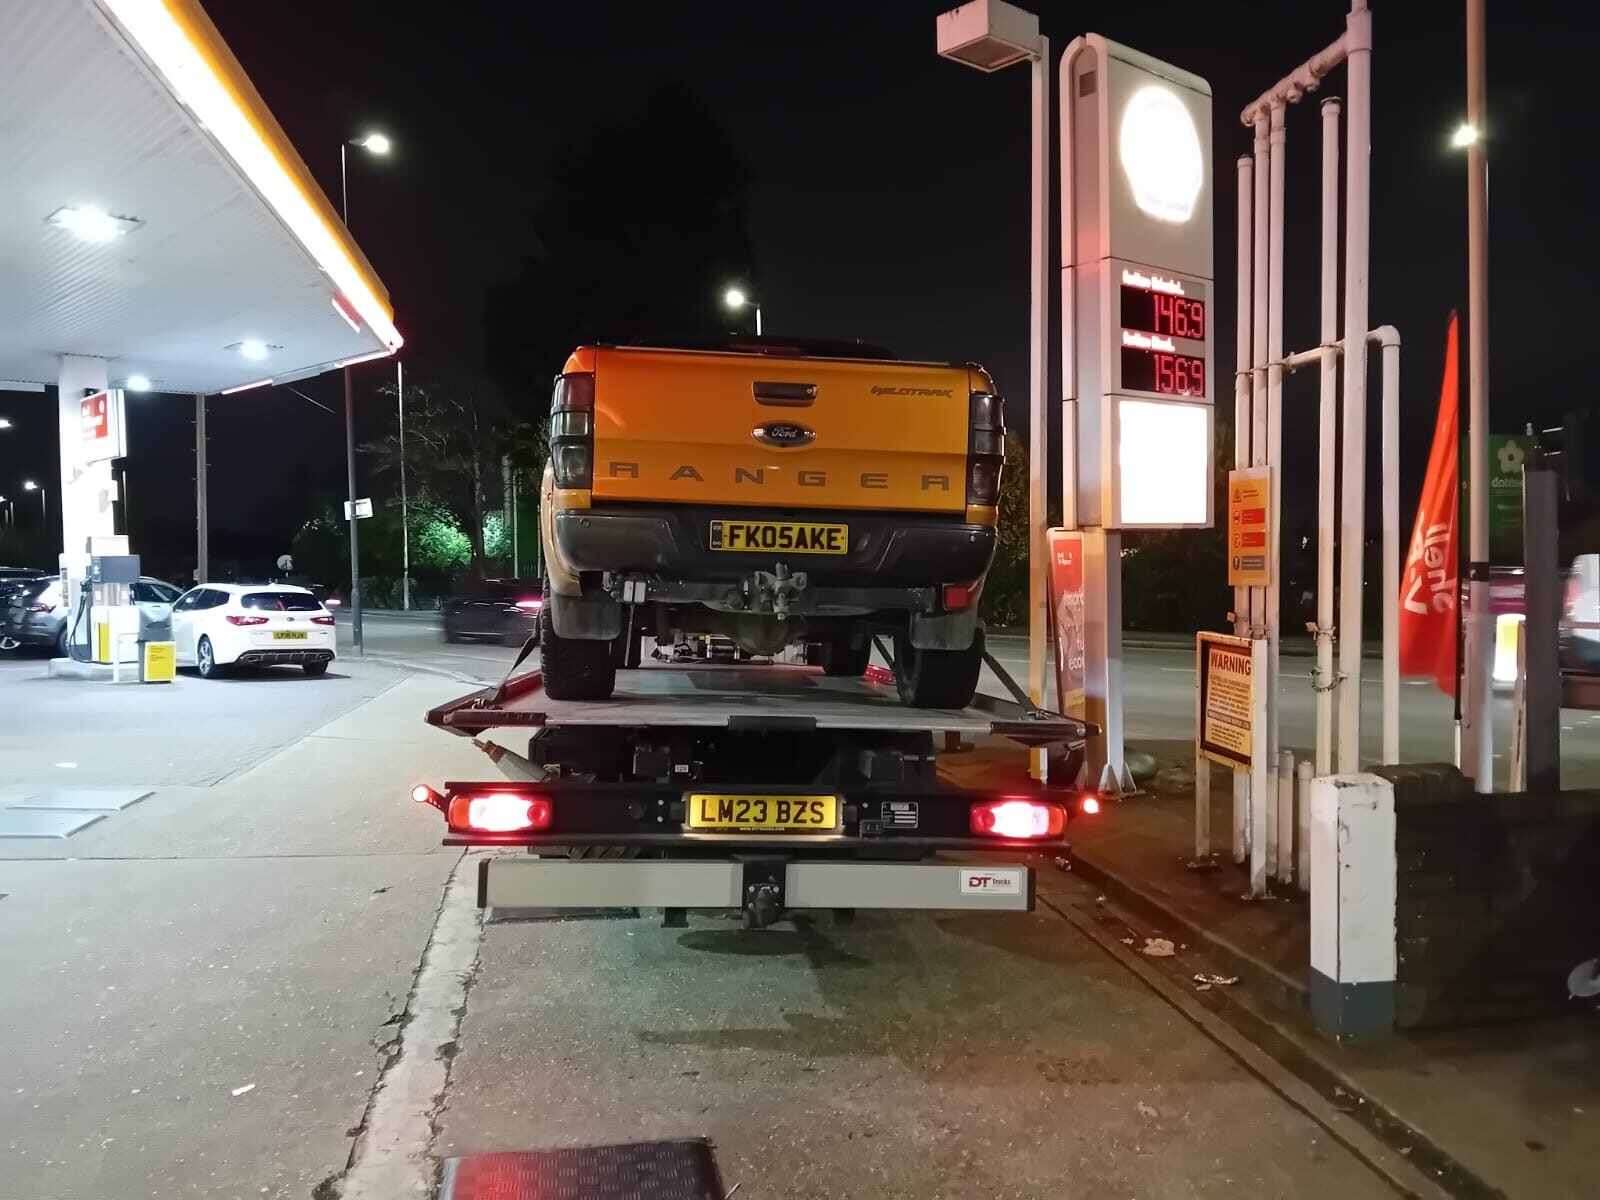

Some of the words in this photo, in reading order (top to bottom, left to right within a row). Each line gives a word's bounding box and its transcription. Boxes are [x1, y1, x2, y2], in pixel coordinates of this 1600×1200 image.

[1154, 294, 1203, 338] 146.9
[1154, 353, 1203, 396] 156.9
[870, 385, 953, 399] WILDTRAK
[771, 427, 798, 439] Ford
[609, 461, 950, 491] RANGER
[1210, 651, 1251, 676] WARNING
[700, 799, 768, 823] LM23
[775, 799, 825, 824] BZS
[968, 876, 992, 888] DT
